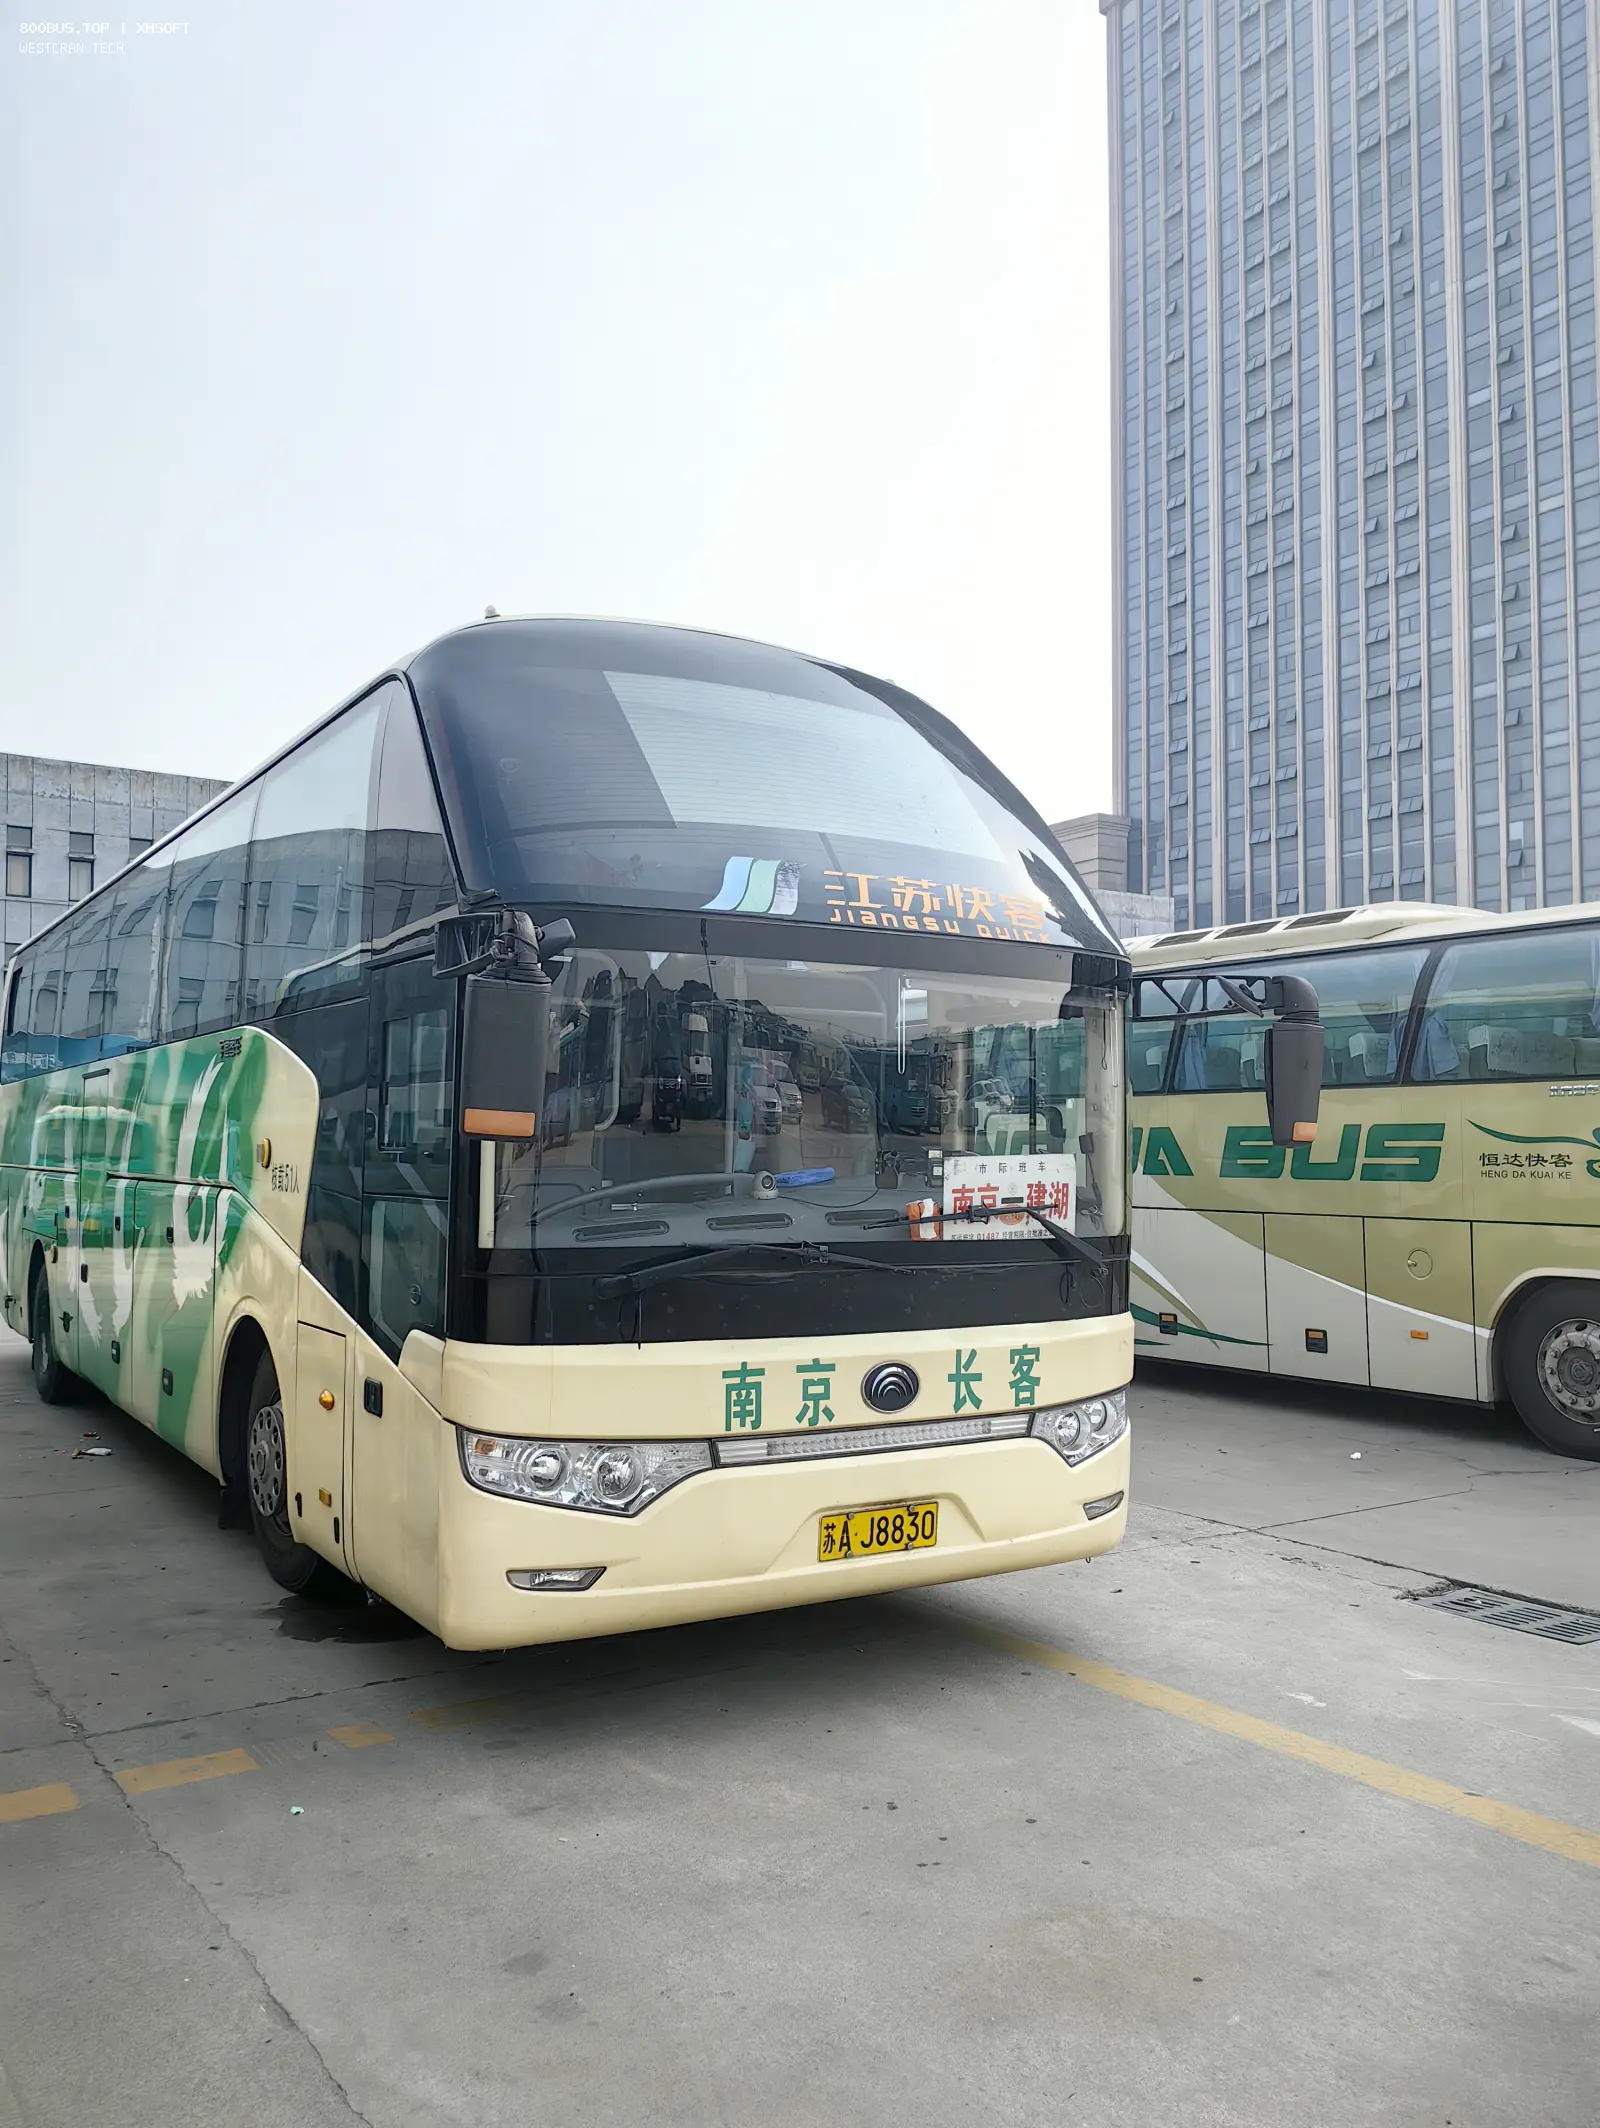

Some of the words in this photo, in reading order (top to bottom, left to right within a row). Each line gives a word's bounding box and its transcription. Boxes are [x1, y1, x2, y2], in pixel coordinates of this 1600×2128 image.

[823, 870, 1047, 931] 江苏快客
[1219, 1122, 1446, 1182] BUS
[1479, 1153, 1573, 1168] 恒达快客
[1480, 1170, 1508, 1178] HENG
[1530, 1171, 1554, 1179] KUAI
[1558, 1171, 1572, 1179] KE
[722, 1357, 836, 1432] 南京
[947, 1343, 1041, 1414] 长客
